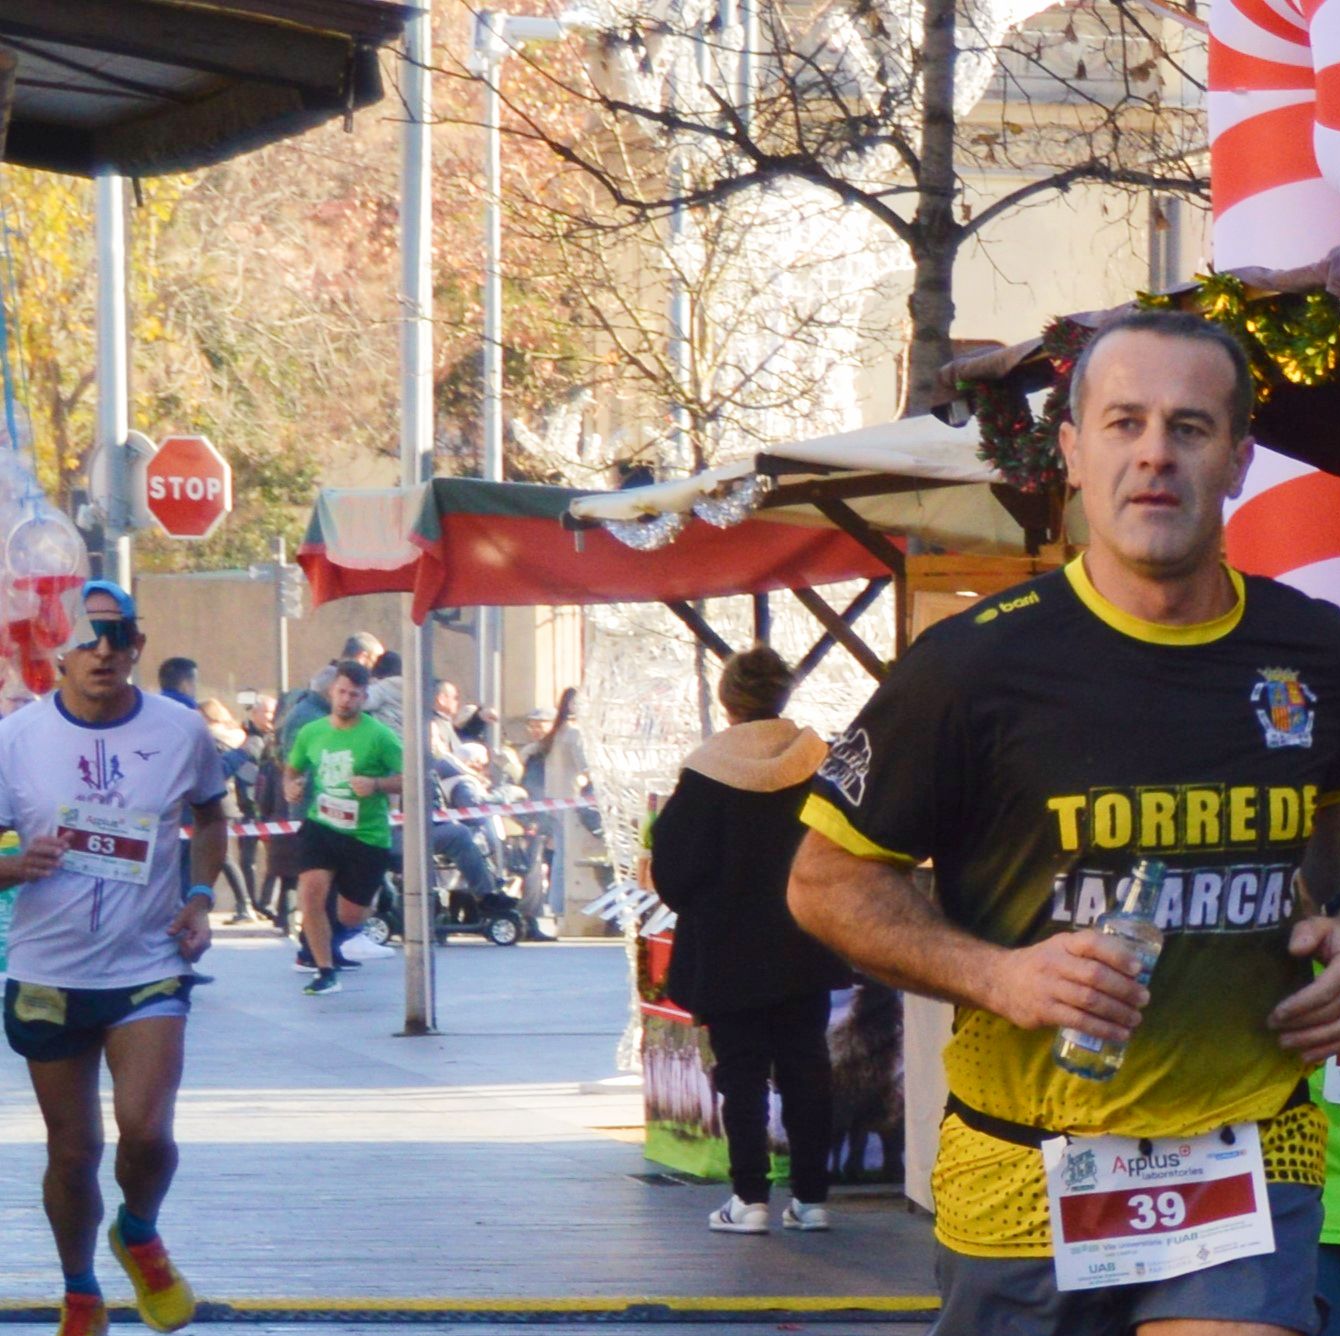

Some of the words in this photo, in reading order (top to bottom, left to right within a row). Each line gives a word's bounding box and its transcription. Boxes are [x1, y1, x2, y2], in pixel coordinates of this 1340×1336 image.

[149, 475, 221, 501] STOP
[1047, 786, 1258, 851] TORRE
[87, 834, 116, 855] 63
[1142, 1166, 1204, 1181] laboratories
[1127, 1190, 1187, 1231] 39
[1088, 1262, 1116, 1275] UAB
